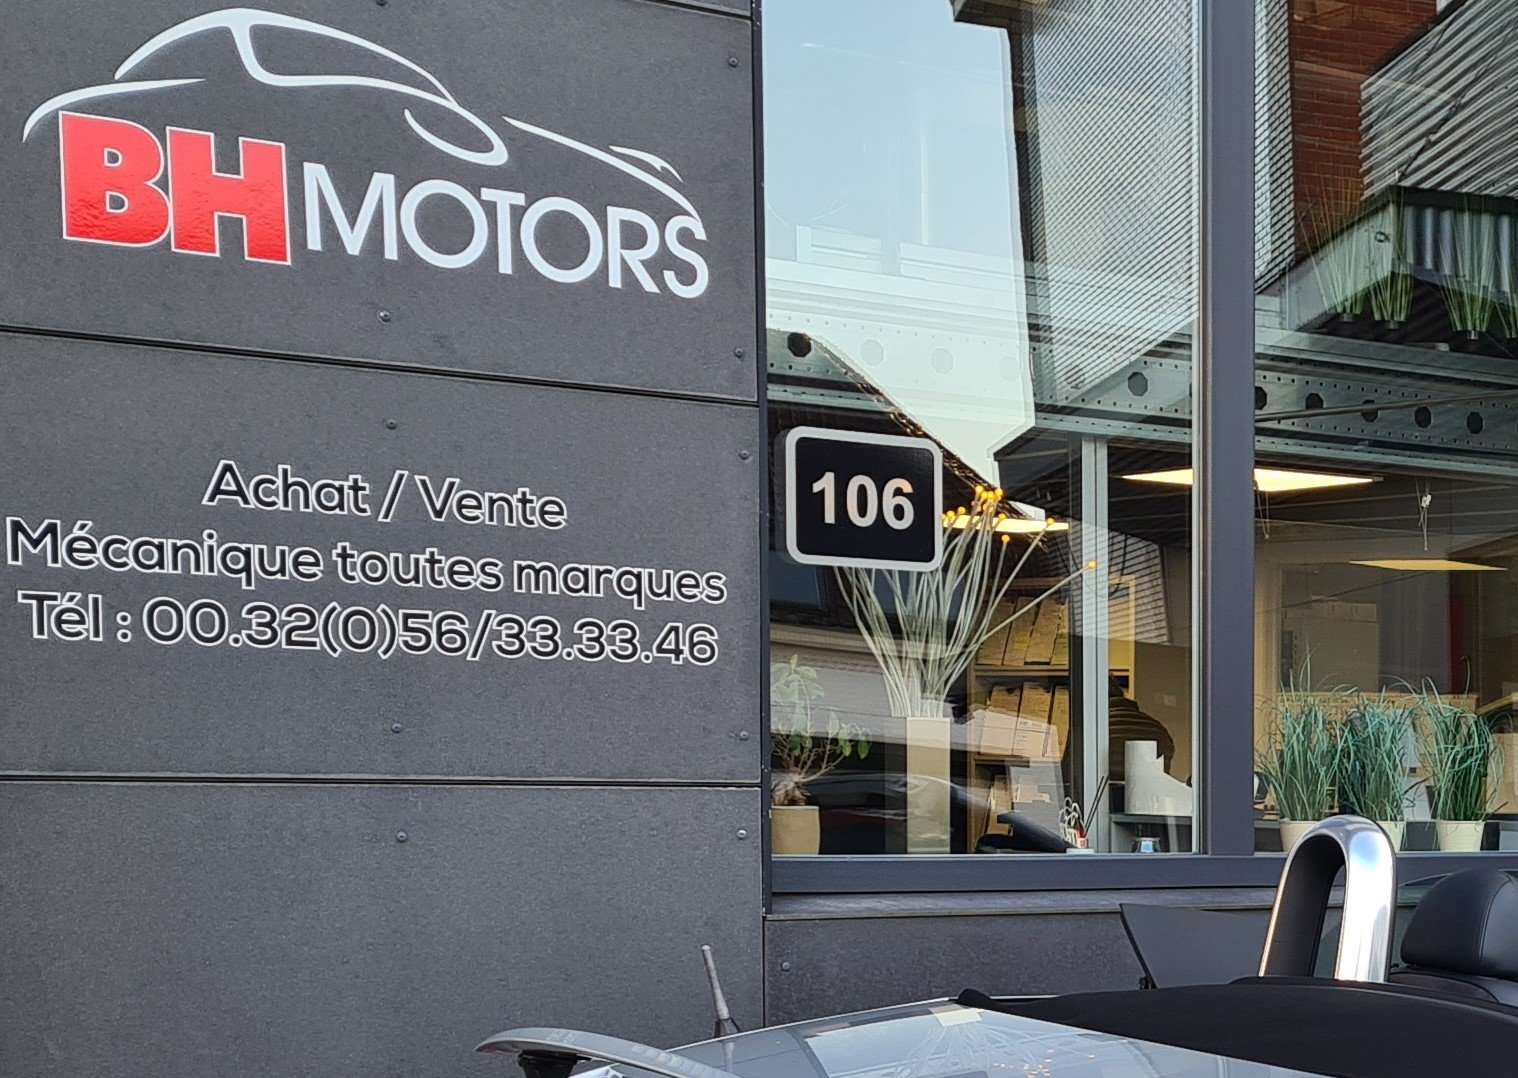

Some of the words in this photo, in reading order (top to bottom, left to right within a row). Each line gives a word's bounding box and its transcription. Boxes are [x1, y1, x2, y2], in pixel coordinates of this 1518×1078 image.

[59, 111, 292, 266] BH
[302, 161, 709, 299] MOTORS
[202, 459, 372, 516] Achat
[377, 470, 409, 522] /
[414, 474, 568, 529] Vente
[812, 471, 915, 531] 106
[6, 516, 324, 590] Mécanique
[332, 541, 504, 592] toutes
[513, 559, 727, 611] marques
[17, 590, 104, 642] Tél
[142, 596, 719, 665] 00.32(0)56/33.33.46
